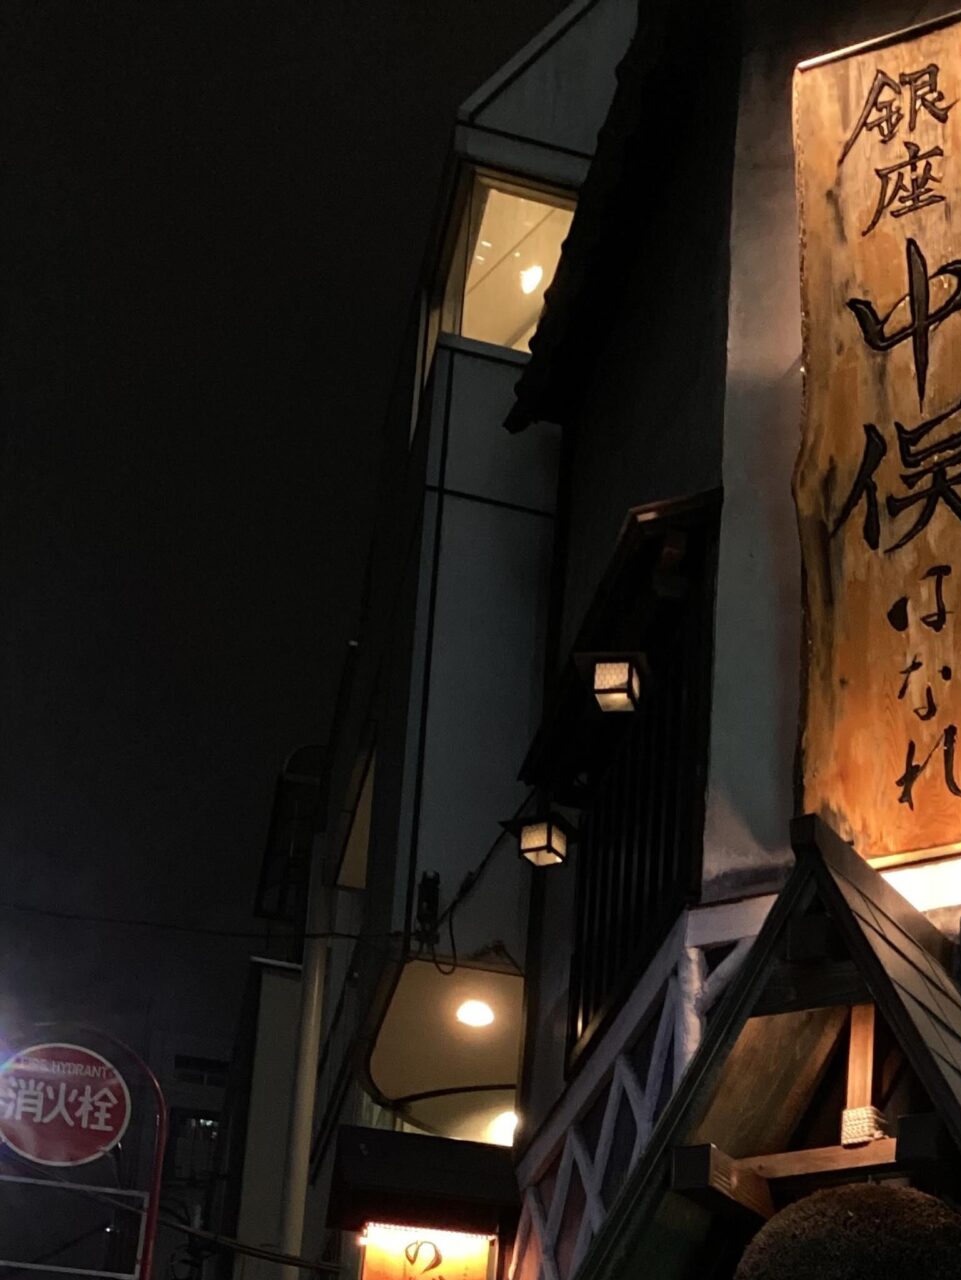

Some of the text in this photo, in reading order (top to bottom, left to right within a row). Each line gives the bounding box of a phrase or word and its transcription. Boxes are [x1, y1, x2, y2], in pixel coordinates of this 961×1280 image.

[51, 1061, 109, 1079] HYDRANT
[1, 1076, 118, 1132] 消火栓
